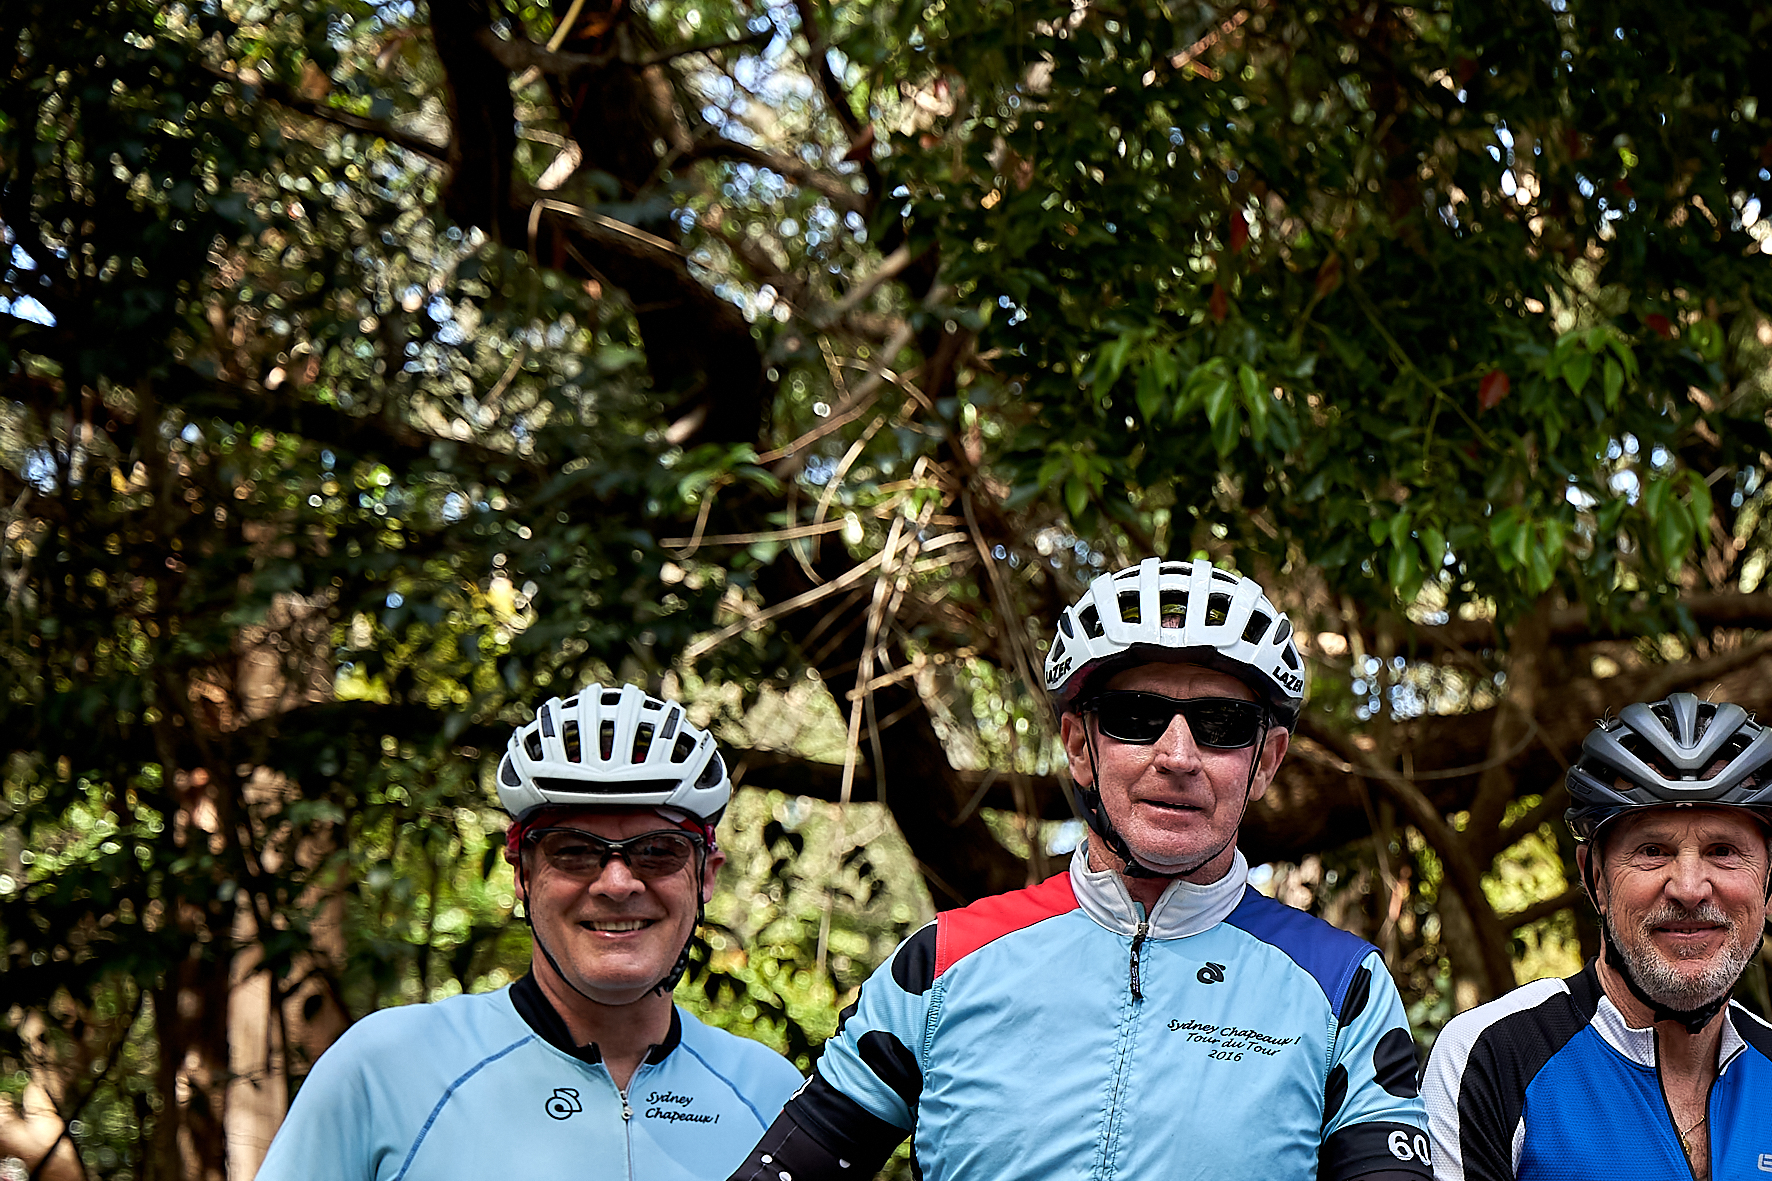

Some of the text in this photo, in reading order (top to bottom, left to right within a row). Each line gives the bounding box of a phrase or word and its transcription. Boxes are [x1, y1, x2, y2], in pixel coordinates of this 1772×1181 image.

[1167, 1018, 1219, 1033] Sydney
[1185, 1032, 1281, 1057] Tour du Tour
[1208, 1049, 1243, 1063] 2016
[646, 1091, 693, 1107] Sydney
